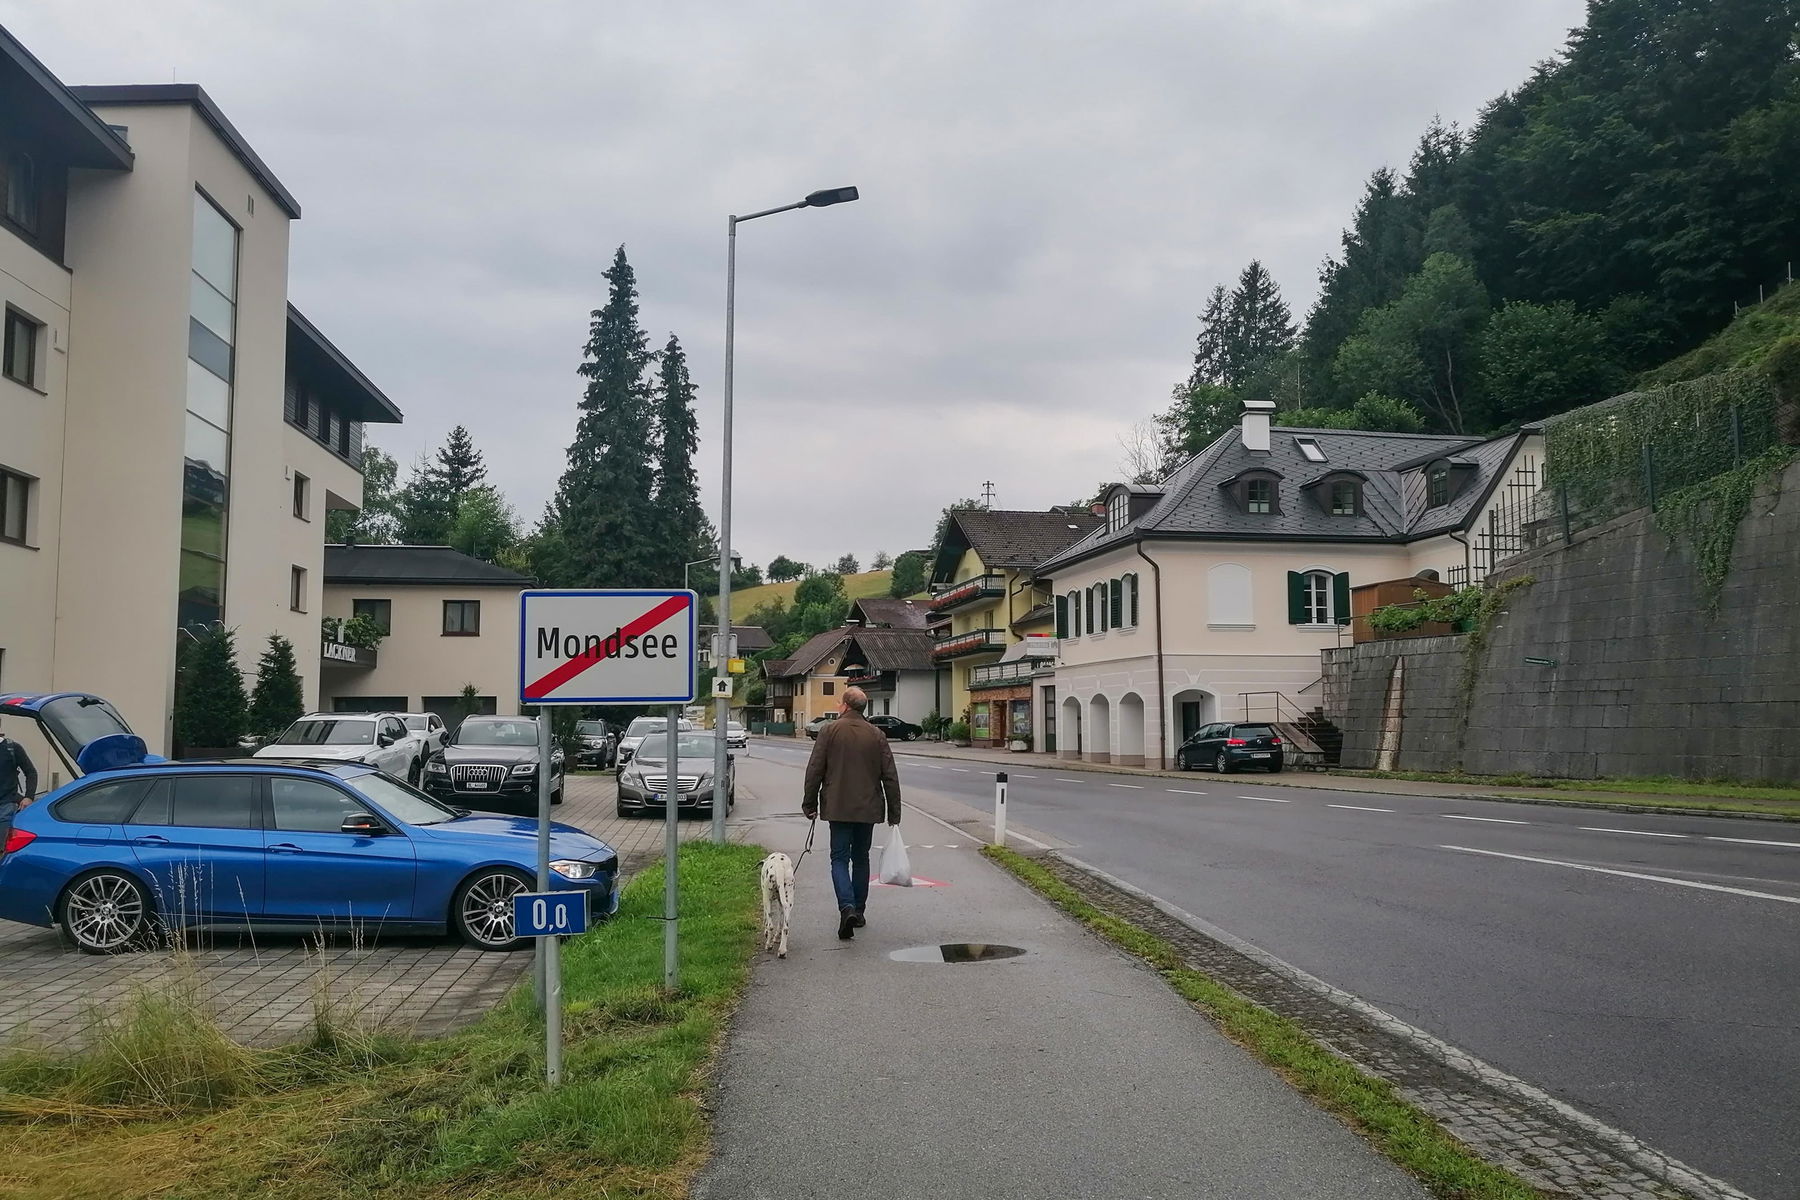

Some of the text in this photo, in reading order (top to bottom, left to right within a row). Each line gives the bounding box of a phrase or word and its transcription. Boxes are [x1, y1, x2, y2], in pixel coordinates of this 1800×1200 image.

[323, 641, 356, 663] LACKNER
[537, 627, 678, 659] Mondsee
[532, 899, 567, 931] 0,0
